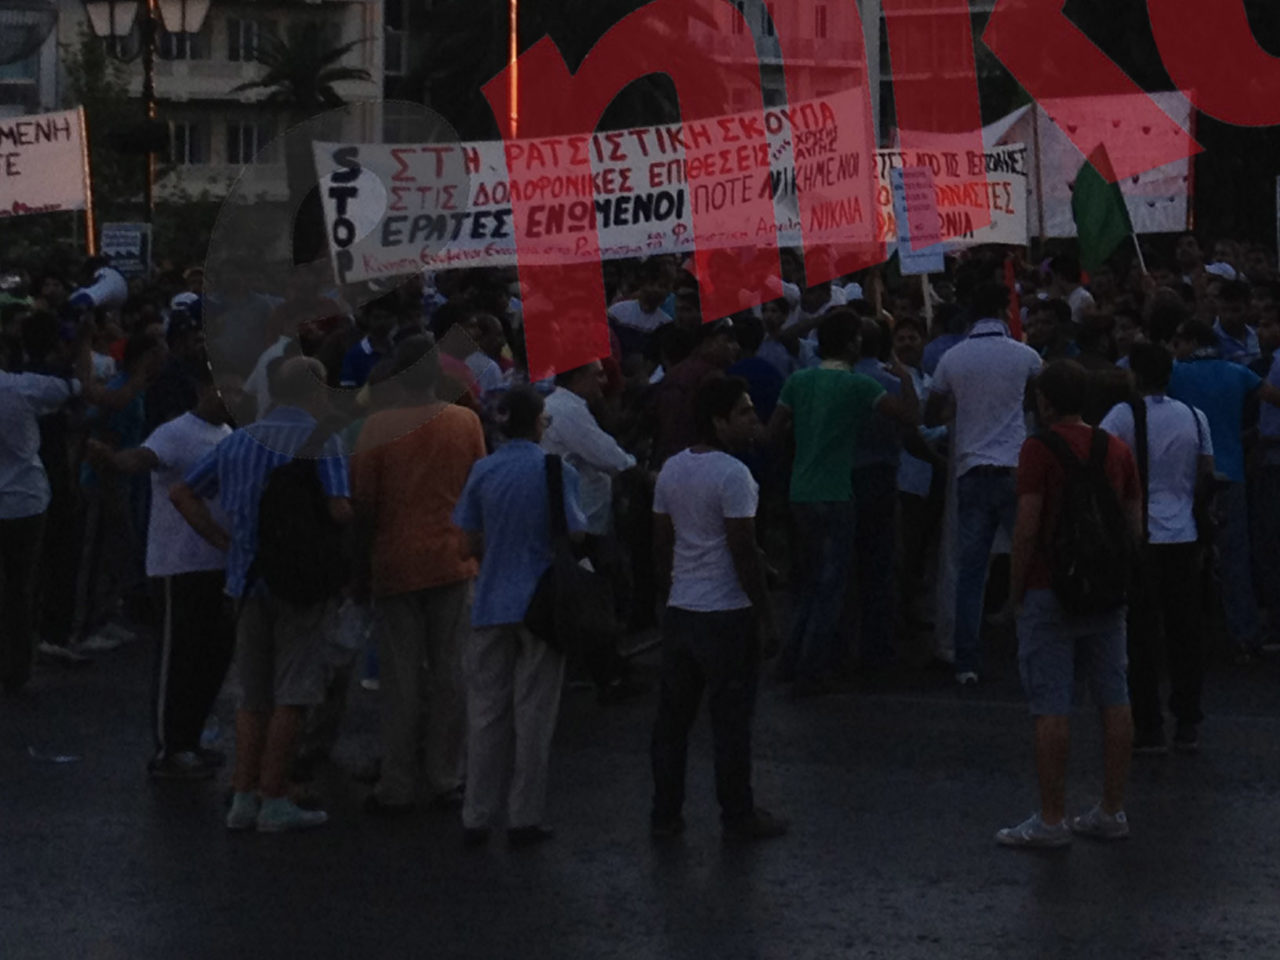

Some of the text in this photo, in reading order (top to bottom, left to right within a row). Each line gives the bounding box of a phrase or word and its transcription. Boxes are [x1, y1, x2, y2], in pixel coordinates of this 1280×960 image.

[389, 184, 457, 211] ΣΤΙΣ
[473, 167, 634, 207] ΔΟΛΟΦΟΝΙΚΕΣ
[649, 142, 771, 188] ΕΠΙΘΕΣΕΙΣ
[390, 101, 837, 183] ΣΤΗ ΡΑΤΣΙΣΤΙΚΗ ΣΚΟΥΠΑ
[328, 146, 361, 283] STOP
[525, 189, 685, 239] ΕΝΩΜΕΝΟΙ
[694, 174, 754, 215] ΠΟΤΕ
[758, 151, 860, 201] ΝΙΚΗΜΕΝΟΙ
